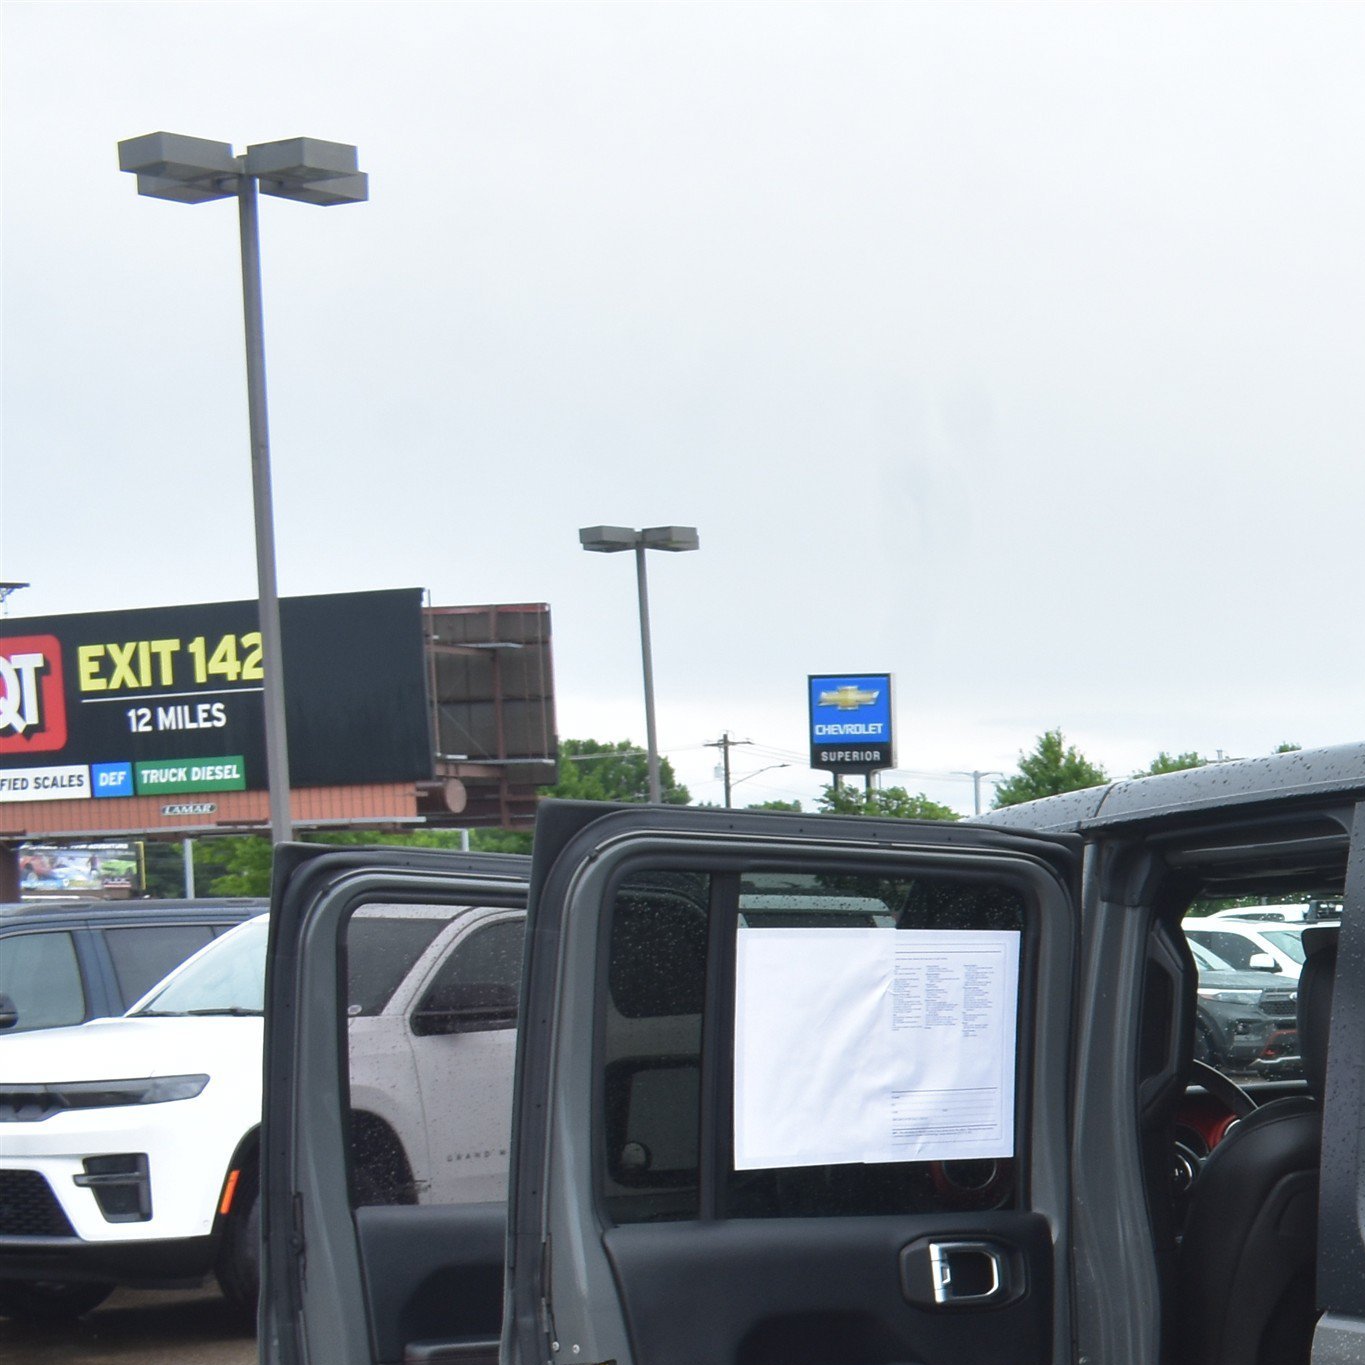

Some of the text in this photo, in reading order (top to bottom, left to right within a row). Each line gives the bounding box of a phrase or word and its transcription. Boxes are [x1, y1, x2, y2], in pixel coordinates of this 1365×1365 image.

[78, 632, 265, 692] EXIT 142
[127, 703, 227, 733] 12 MILES
[814, 723, 884, 736] CHEVROLET
[820, 750, 881, 762] SUPERIOR
[34, 774, 85, 790] SCALES
[99, 771, 126, 787] DEF
[141, 764, 241, 784] TRUCK DIESEL
[164, 803, 213, 815] LAMAR
[446, 1150, 491, 1162] GRAND
